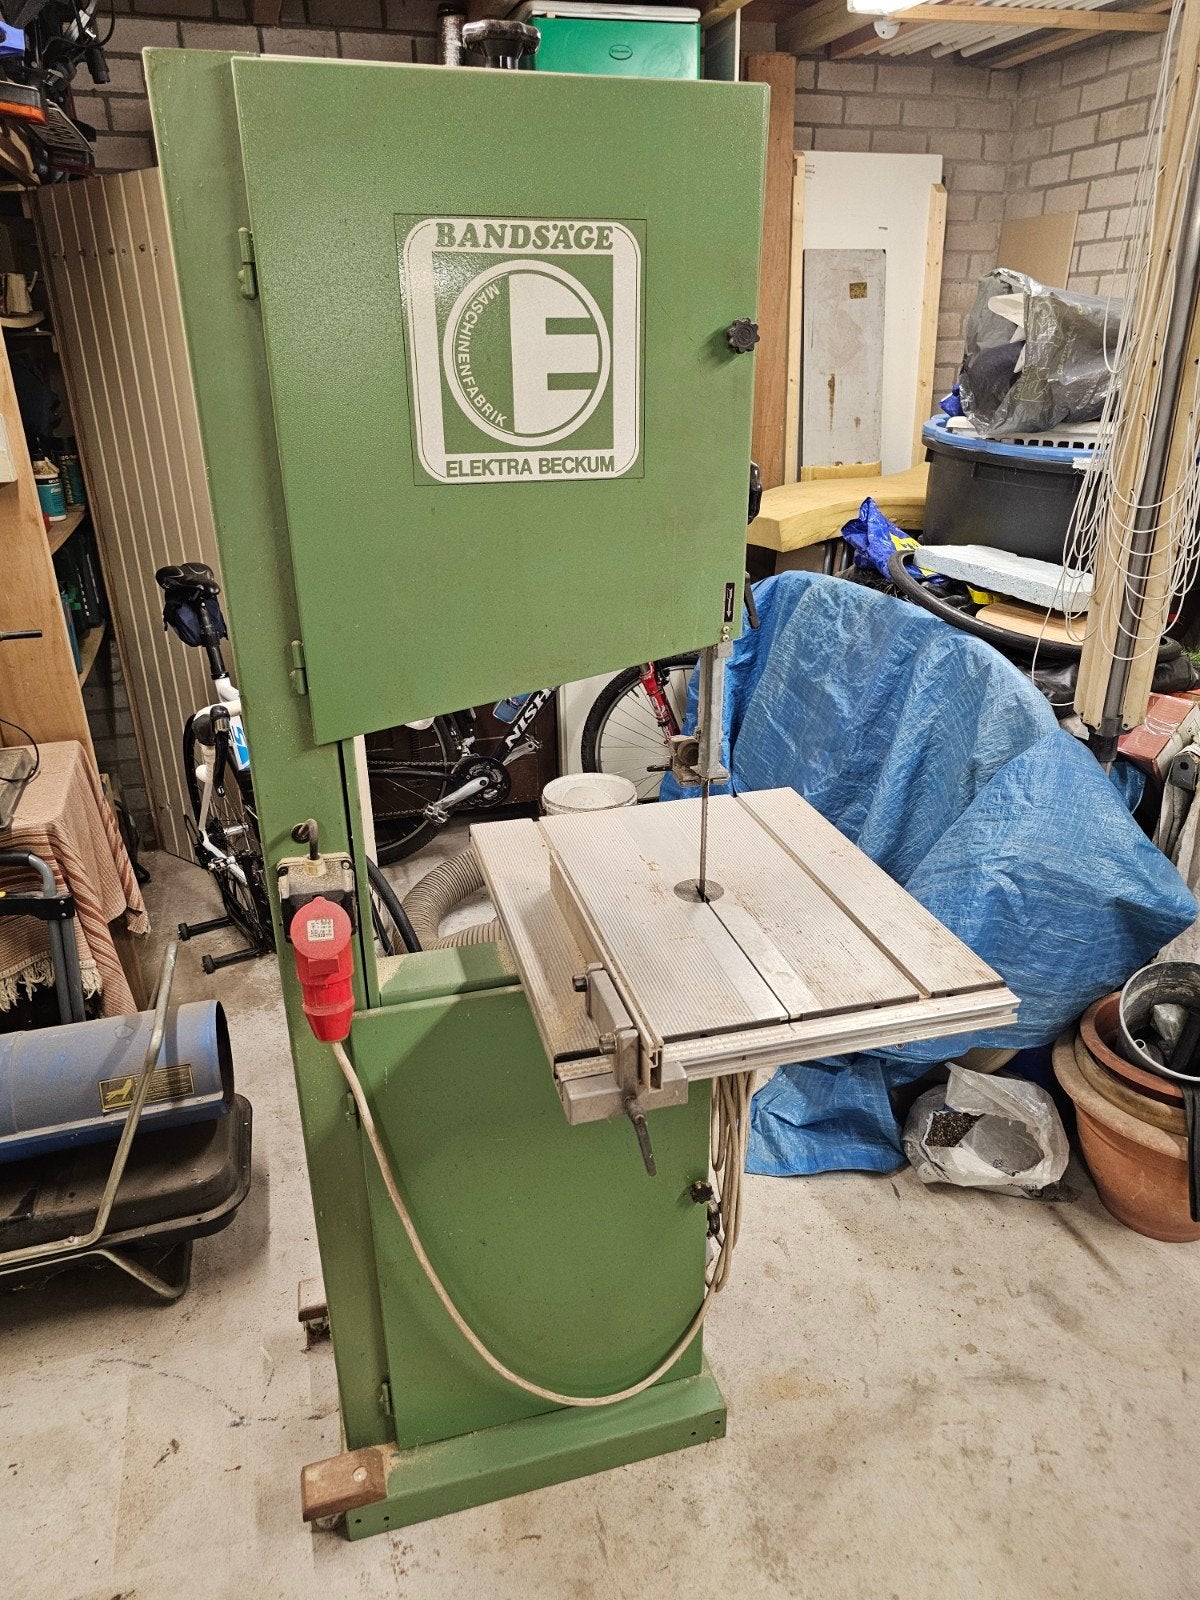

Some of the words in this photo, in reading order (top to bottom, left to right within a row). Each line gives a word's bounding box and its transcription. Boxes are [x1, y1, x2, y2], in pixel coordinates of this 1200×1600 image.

[435, 222, 614, 250] BANDSÄGE
[457, 283, 508, 427] MASCHINENFABRIK
[446, 458, 533, 478] ELEKTRA
[538, 455, 615, 475] BECKUM
